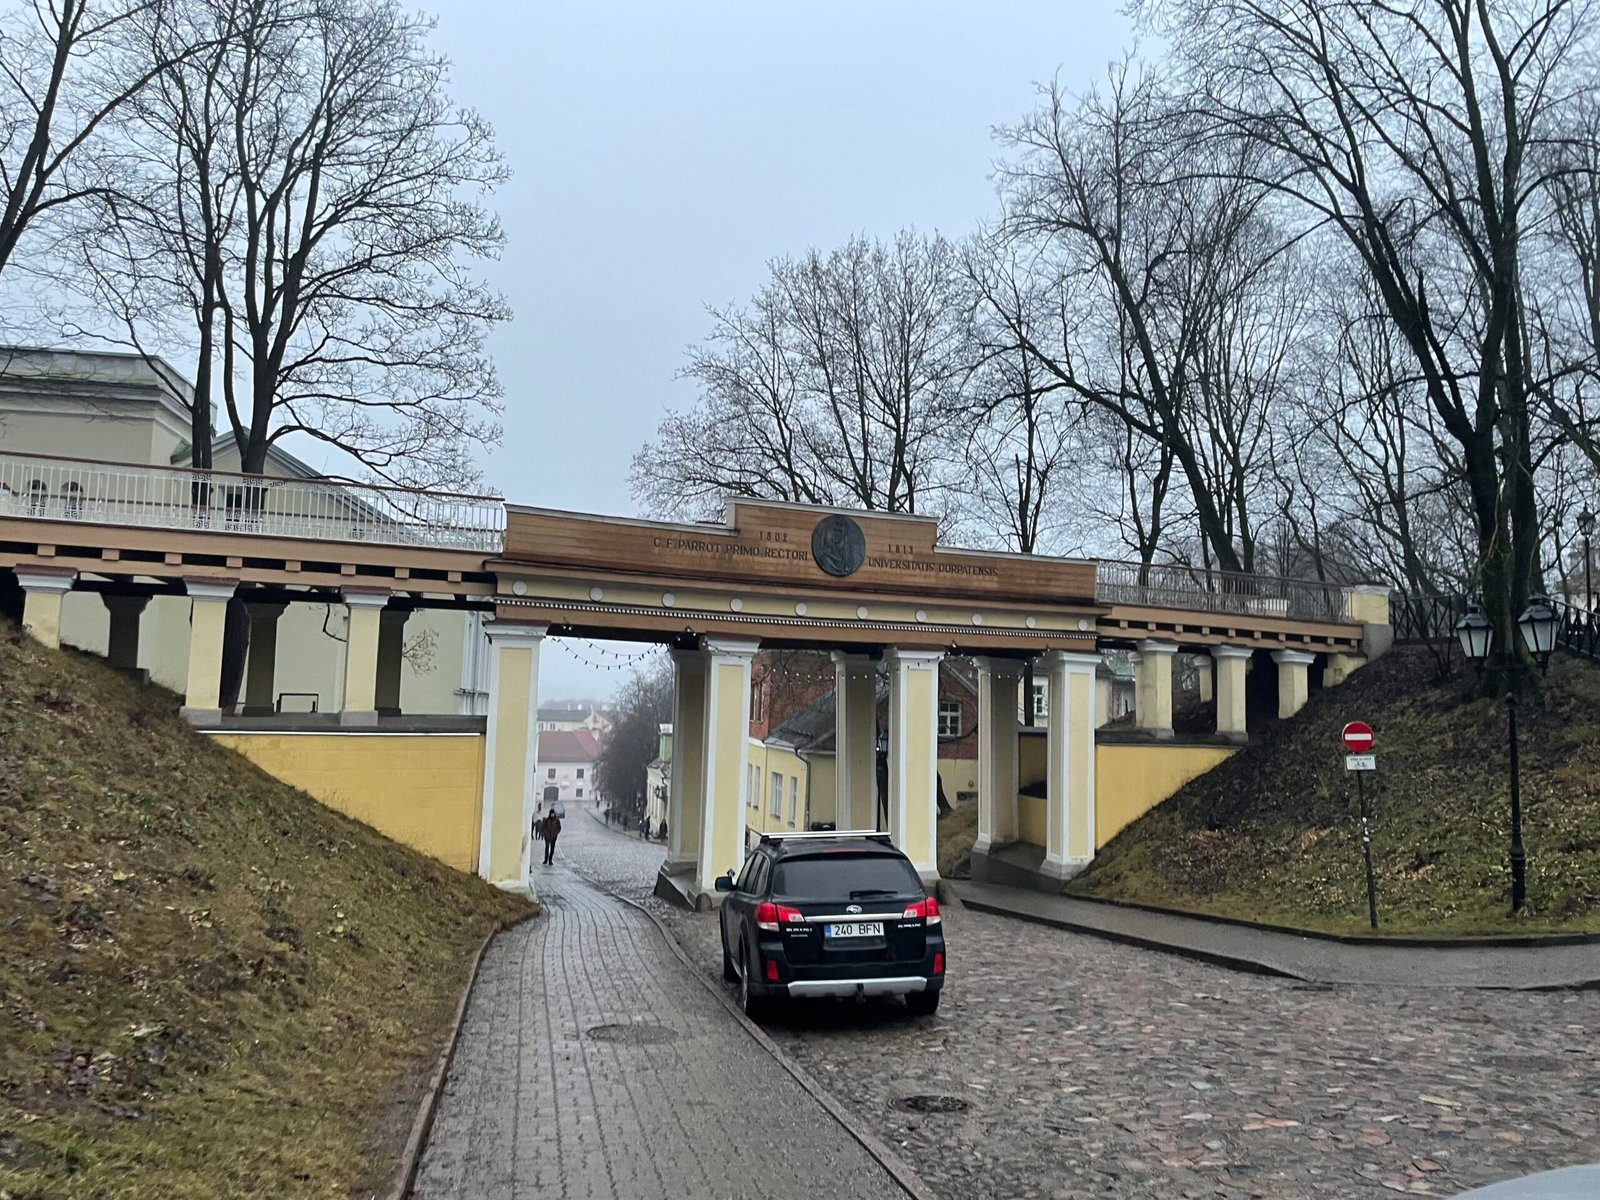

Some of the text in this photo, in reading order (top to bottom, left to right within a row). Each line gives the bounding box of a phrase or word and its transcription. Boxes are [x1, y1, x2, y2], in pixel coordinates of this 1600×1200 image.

[759, 531, 788, 543] 1802
[678, 539, 721, 553] PARROT
[726, 544, 760, 556] PRIMO
[764, 547, 808, 561] RECTORI
[868, 557, 998, 576] UNIVERSITATIS DORPATENSIS
[834, 923, 881, 936] 240 BFN
